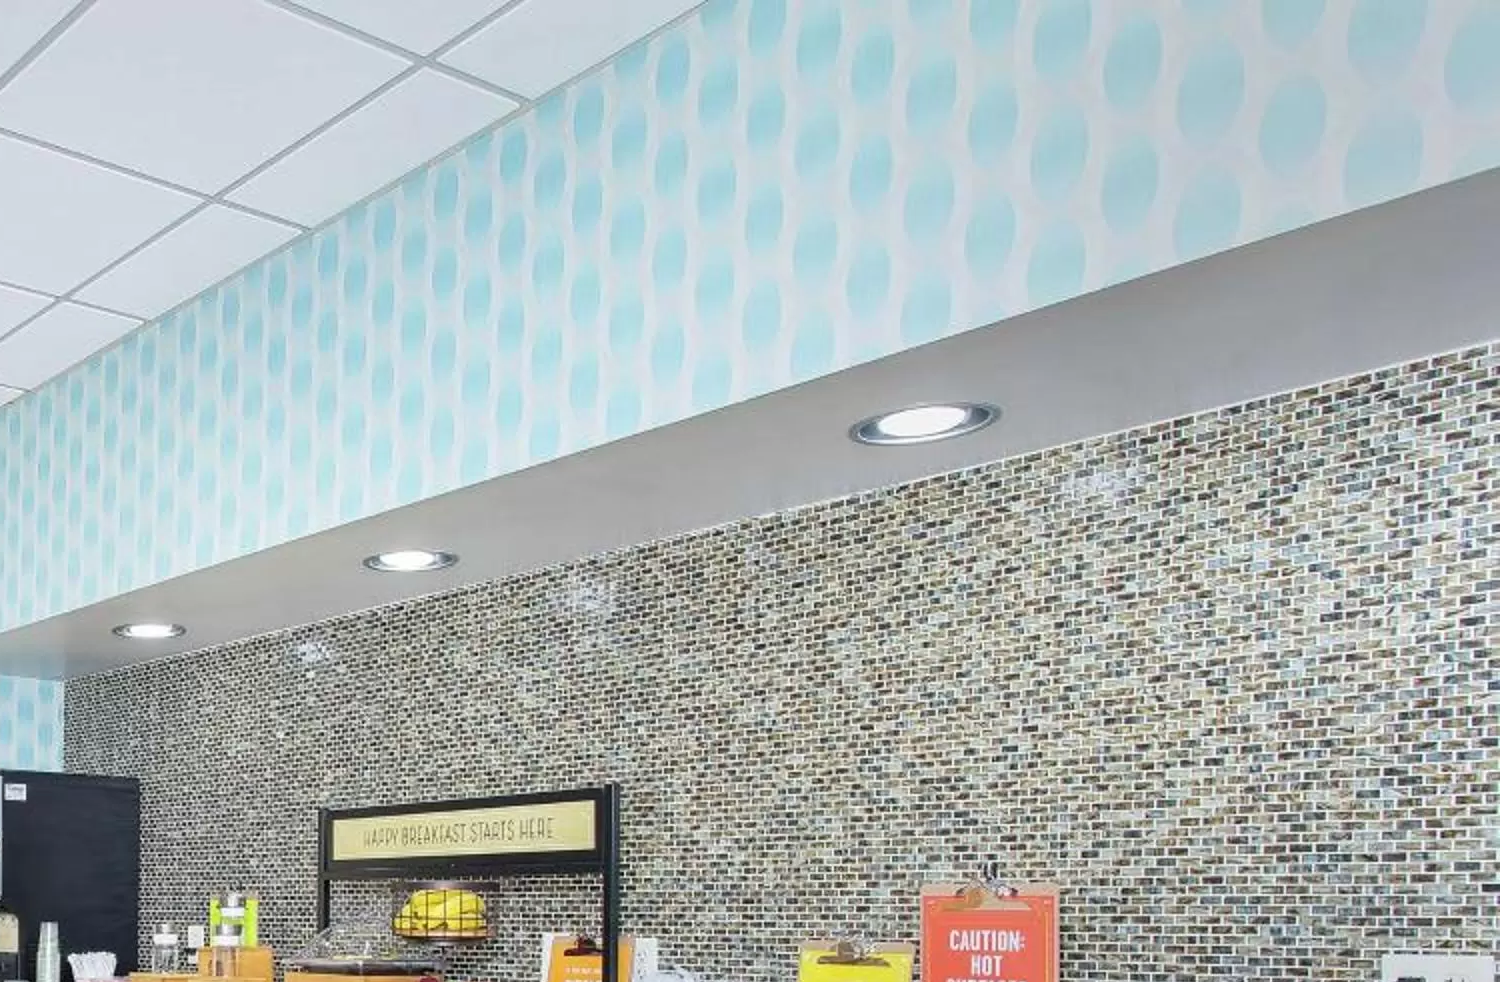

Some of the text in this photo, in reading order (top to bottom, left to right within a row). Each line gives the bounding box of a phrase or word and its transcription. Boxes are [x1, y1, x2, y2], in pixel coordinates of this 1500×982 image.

[363, 817, 556, 847] HAPPY BREAKFAST STARTS HERE
[950, 929, 1026, 951] CAUTION:
[971, 955, 1003, 977] HOT
